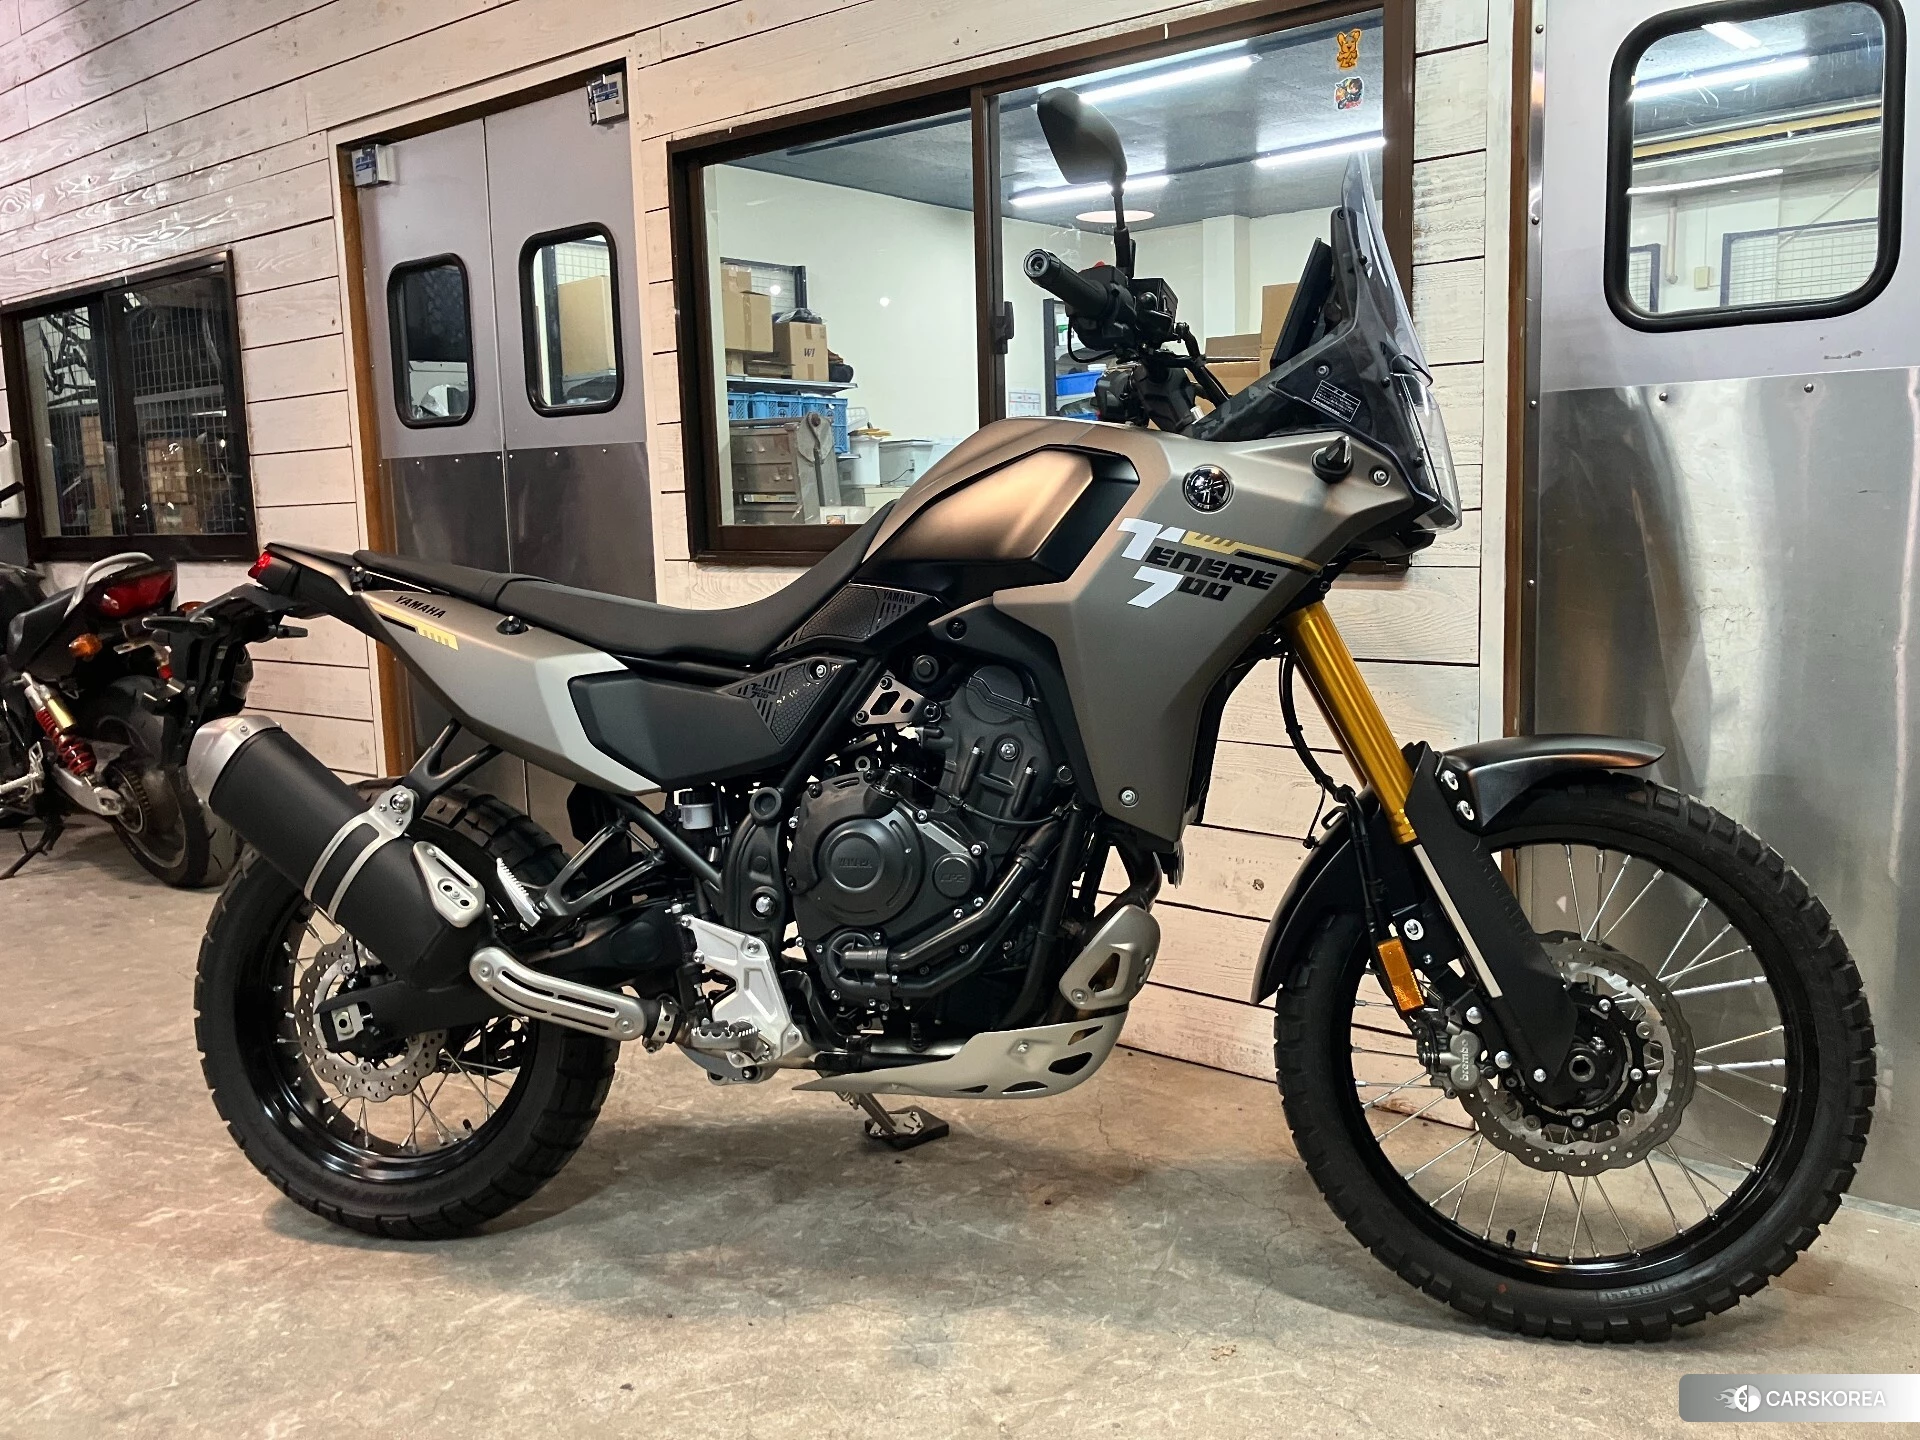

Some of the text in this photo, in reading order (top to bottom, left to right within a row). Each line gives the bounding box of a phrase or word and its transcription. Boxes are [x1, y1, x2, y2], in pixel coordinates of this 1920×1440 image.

[883, 589, 916, 604] YAMAHA
[1126, 565, 1233, 609] 700
[395, 595, 446, 618] YAMAHA
[1460, 1039, 1469, 1081] brembo
